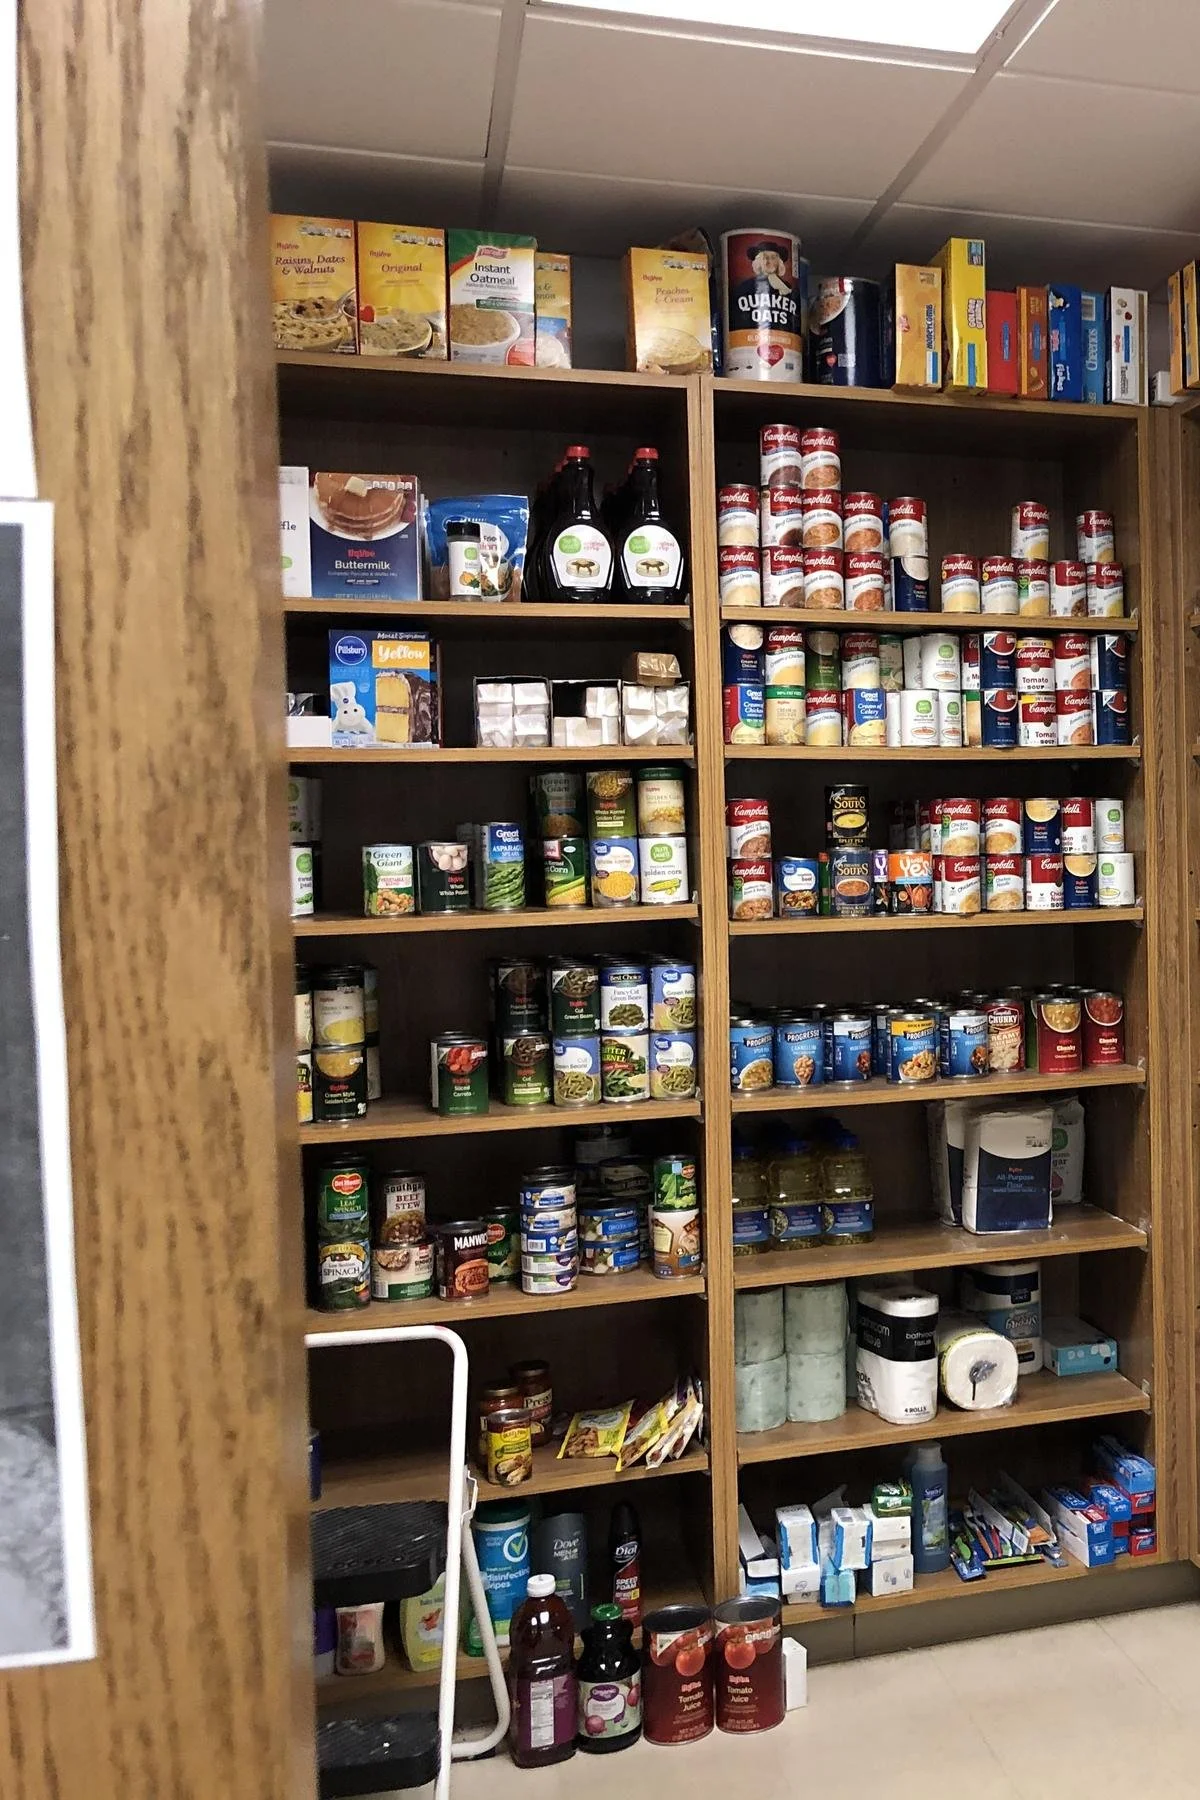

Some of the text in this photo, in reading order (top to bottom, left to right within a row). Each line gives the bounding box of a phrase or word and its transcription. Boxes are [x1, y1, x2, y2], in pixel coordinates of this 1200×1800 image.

[317, 254, 345, 265] Dates
[295, 263, 335, 275] Walnuts
[381, 262, 422, 274] Original
[474, 262, 511, 276] Instant
[470, 273, 515, 286] Oatmeal
[656, 285, 689, 297] Peaches
[665, 293, 694, 304] Cream
[738, 293, 797, 316] QUAKER
[751, 308, 788, 325] OATS
[334, 559, 391, 571] Buttermilk
[337, 644, 366, 657] Pillsbury
[377, 644, 426, 662] Yellow
[1022, 676, 1049, 684] Tomato
[834, 797, 866, 810] SOUPS
[495, 829, 519, 839] Great
[372, 851, 403, 860] Green
[376, 859, 403, 868] Giant
[550, 865, 569, 874] Corn
[643, 869, 665, 879] golden
[836, 863, 869, 876] SOUPS
[988, 1014, 1018, 1025] CHUNKY
[786, 1029, 820, 1042] PROGRESSO
[1098, 1036, 1118, 1045] Chunky
[1056, 1044, 1076, 1052] Chunky
[339, 1199, 356, 1208] LEAF
[396, 1193, 420, 1203] BEEF
[333, 1205, 362, 1213] SPINACH
[394, 1201, 421, 1211] STEW
[322, 1265, 361, 1278] SPINACH
[553, 1536, 581, 1551] Dove
[614, 1545, 638, 1557] Dial
[615, 1576, 638, 1586] SPEED
[616, 1582, 638, 1591] FOAM
[727, 1685, 753, 1696] Tomato
[678, 1690, 704, 1704] Tomato
[731, 1695, 749, 1704] Juice
[682, 1700, 702, 1712] Juice
